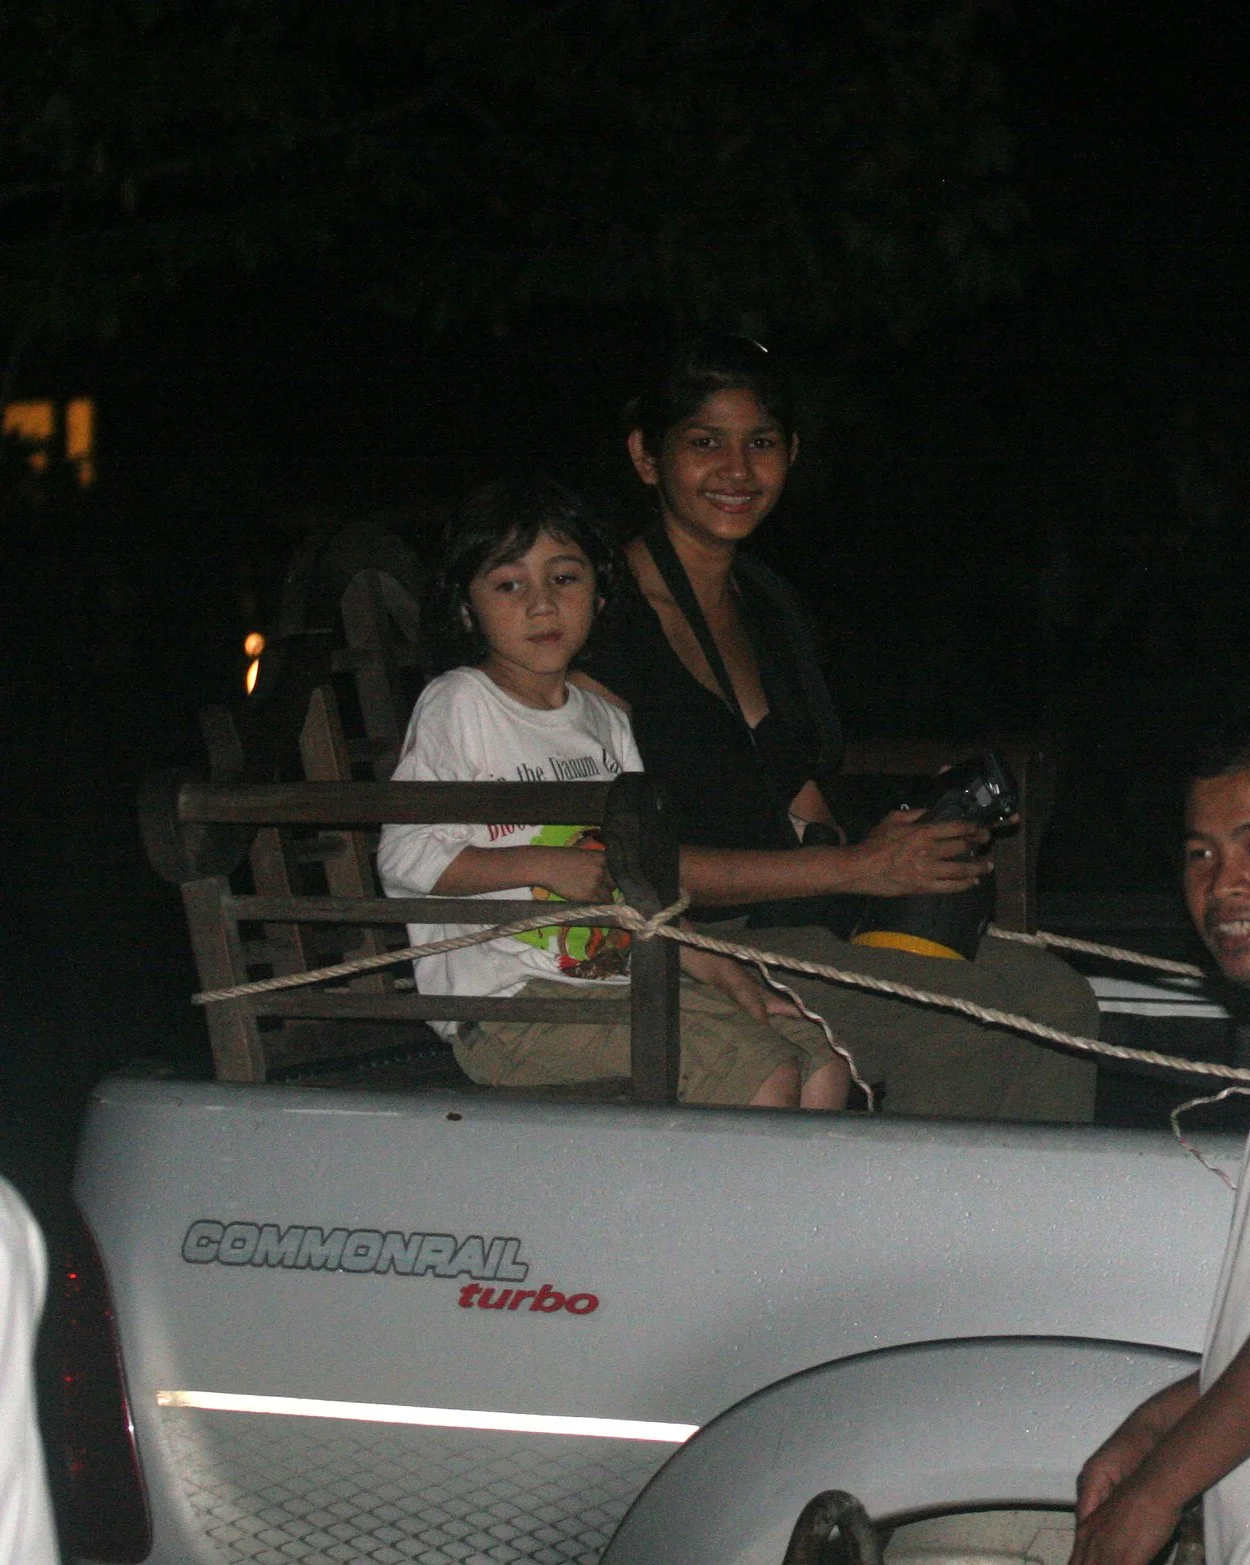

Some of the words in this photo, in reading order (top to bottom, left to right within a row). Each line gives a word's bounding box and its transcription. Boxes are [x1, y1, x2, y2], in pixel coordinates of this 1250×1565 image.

[517, 763, 544, 782] the
[181, 1219, 529, 1282] COMMONRAIL
[458, 1282, 600, 1315] turbo
